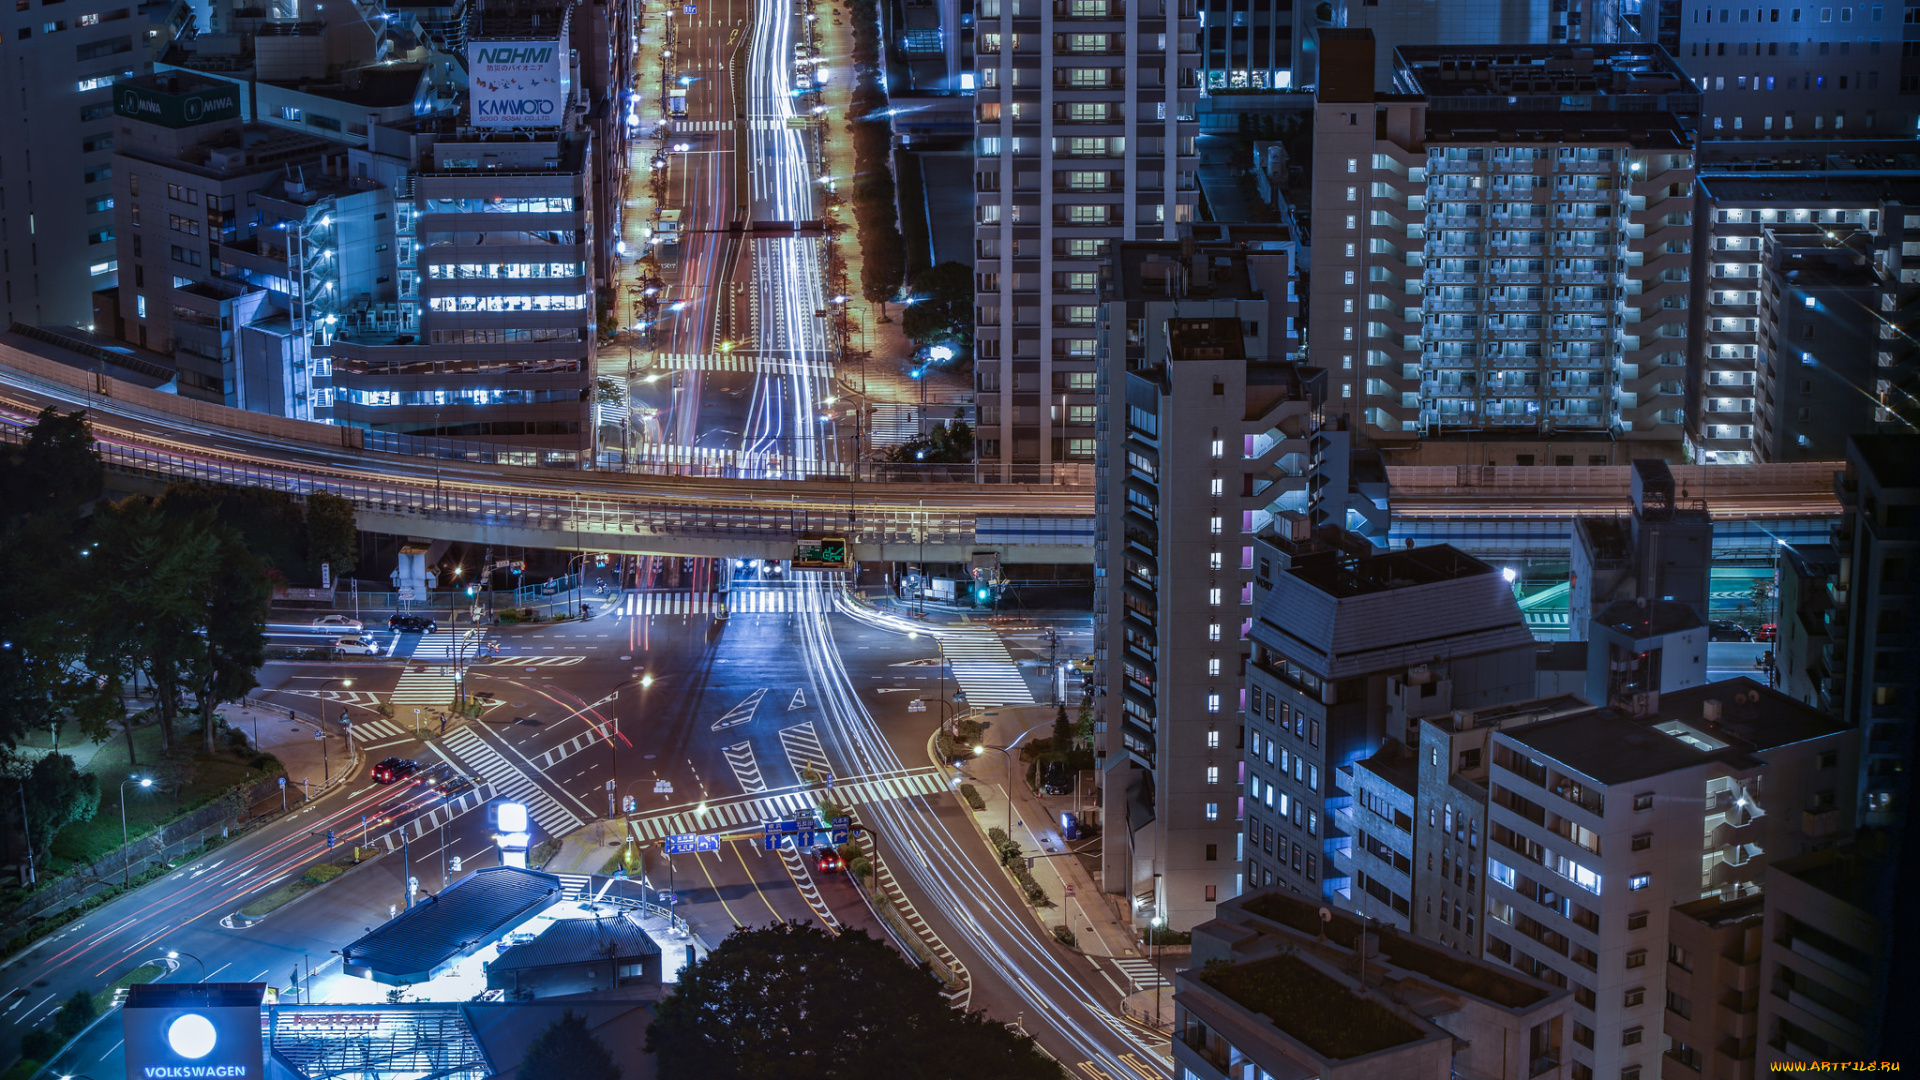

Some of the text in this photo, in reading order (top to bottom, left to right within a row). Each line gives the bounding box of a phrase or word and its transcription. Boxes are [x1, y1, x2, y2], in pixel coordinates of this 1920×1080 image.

[477, 48, 552, 64] NOHMI
[139, 99, 161, 114] MIWA
[203, 97, 233, 112] MIWA
[145, 1066, 245, 1078] VOLKSWAGEN
